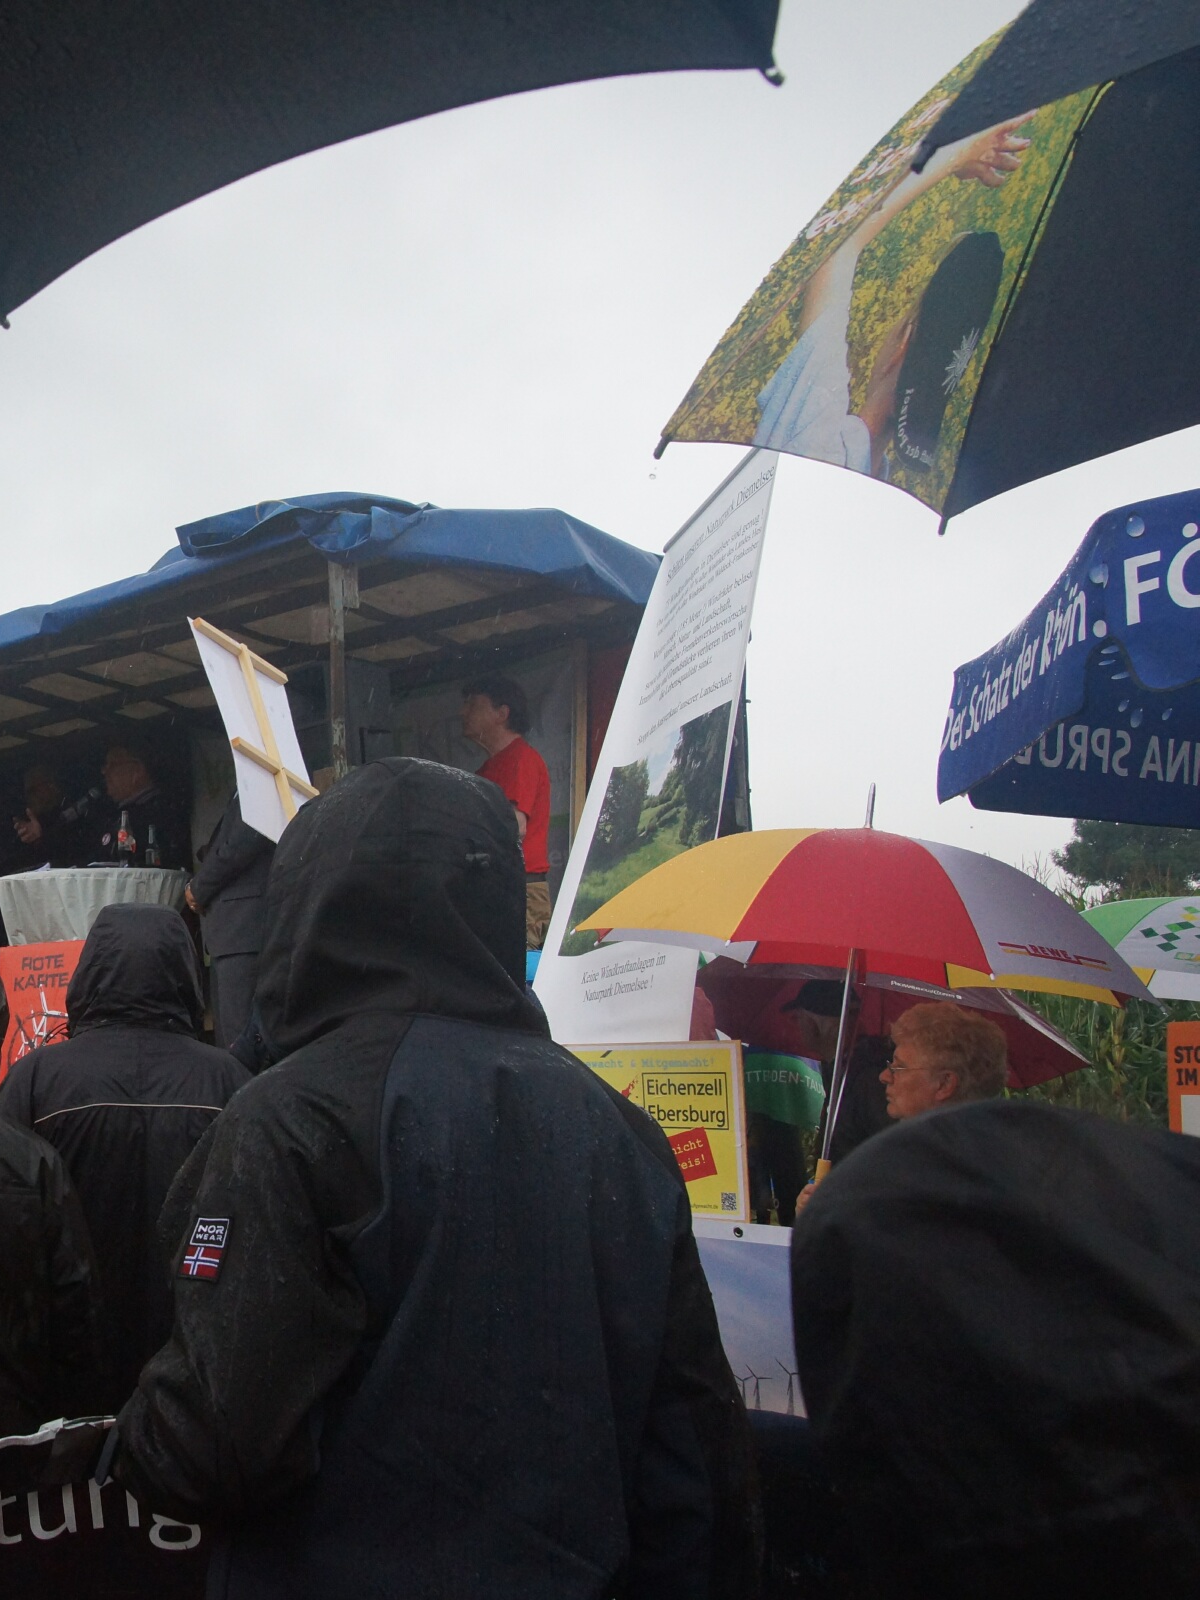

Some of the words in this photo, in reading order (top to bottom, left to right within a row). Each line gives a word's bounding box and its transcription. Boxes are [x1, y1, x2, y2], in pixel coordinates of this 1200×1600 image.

[736, 466, 775, 508] Diemelsee
[940, 708, 967, 754] Der
[966, 667, 1012, 740] Schatz
[1012, 633, 1040, 700] der
[1028, 944, 1072, 959] REWE
[22, 954, 64, 971] ROTE
[581, 969, 600, 984] Keine
[601, 957, 655, 980] Windkraftanlagen
[656, 952, 666, 966] im
[14, 972, 69, 992] KARTE
[583, 984, 613, 1002] Naturpark
[613, 978, 649, 996] Diemelsee
[1176, 1068, 1198, 1086] IM
[647, 1078, 722, 1096] Eichenzell
[648, 1104, 726, 1127] Ebersburg
[678, 1154, 706, 1170] eis!
[196, 1233, 223, 1242] WEAR
[198, 1224, 225, 1234] NOR
